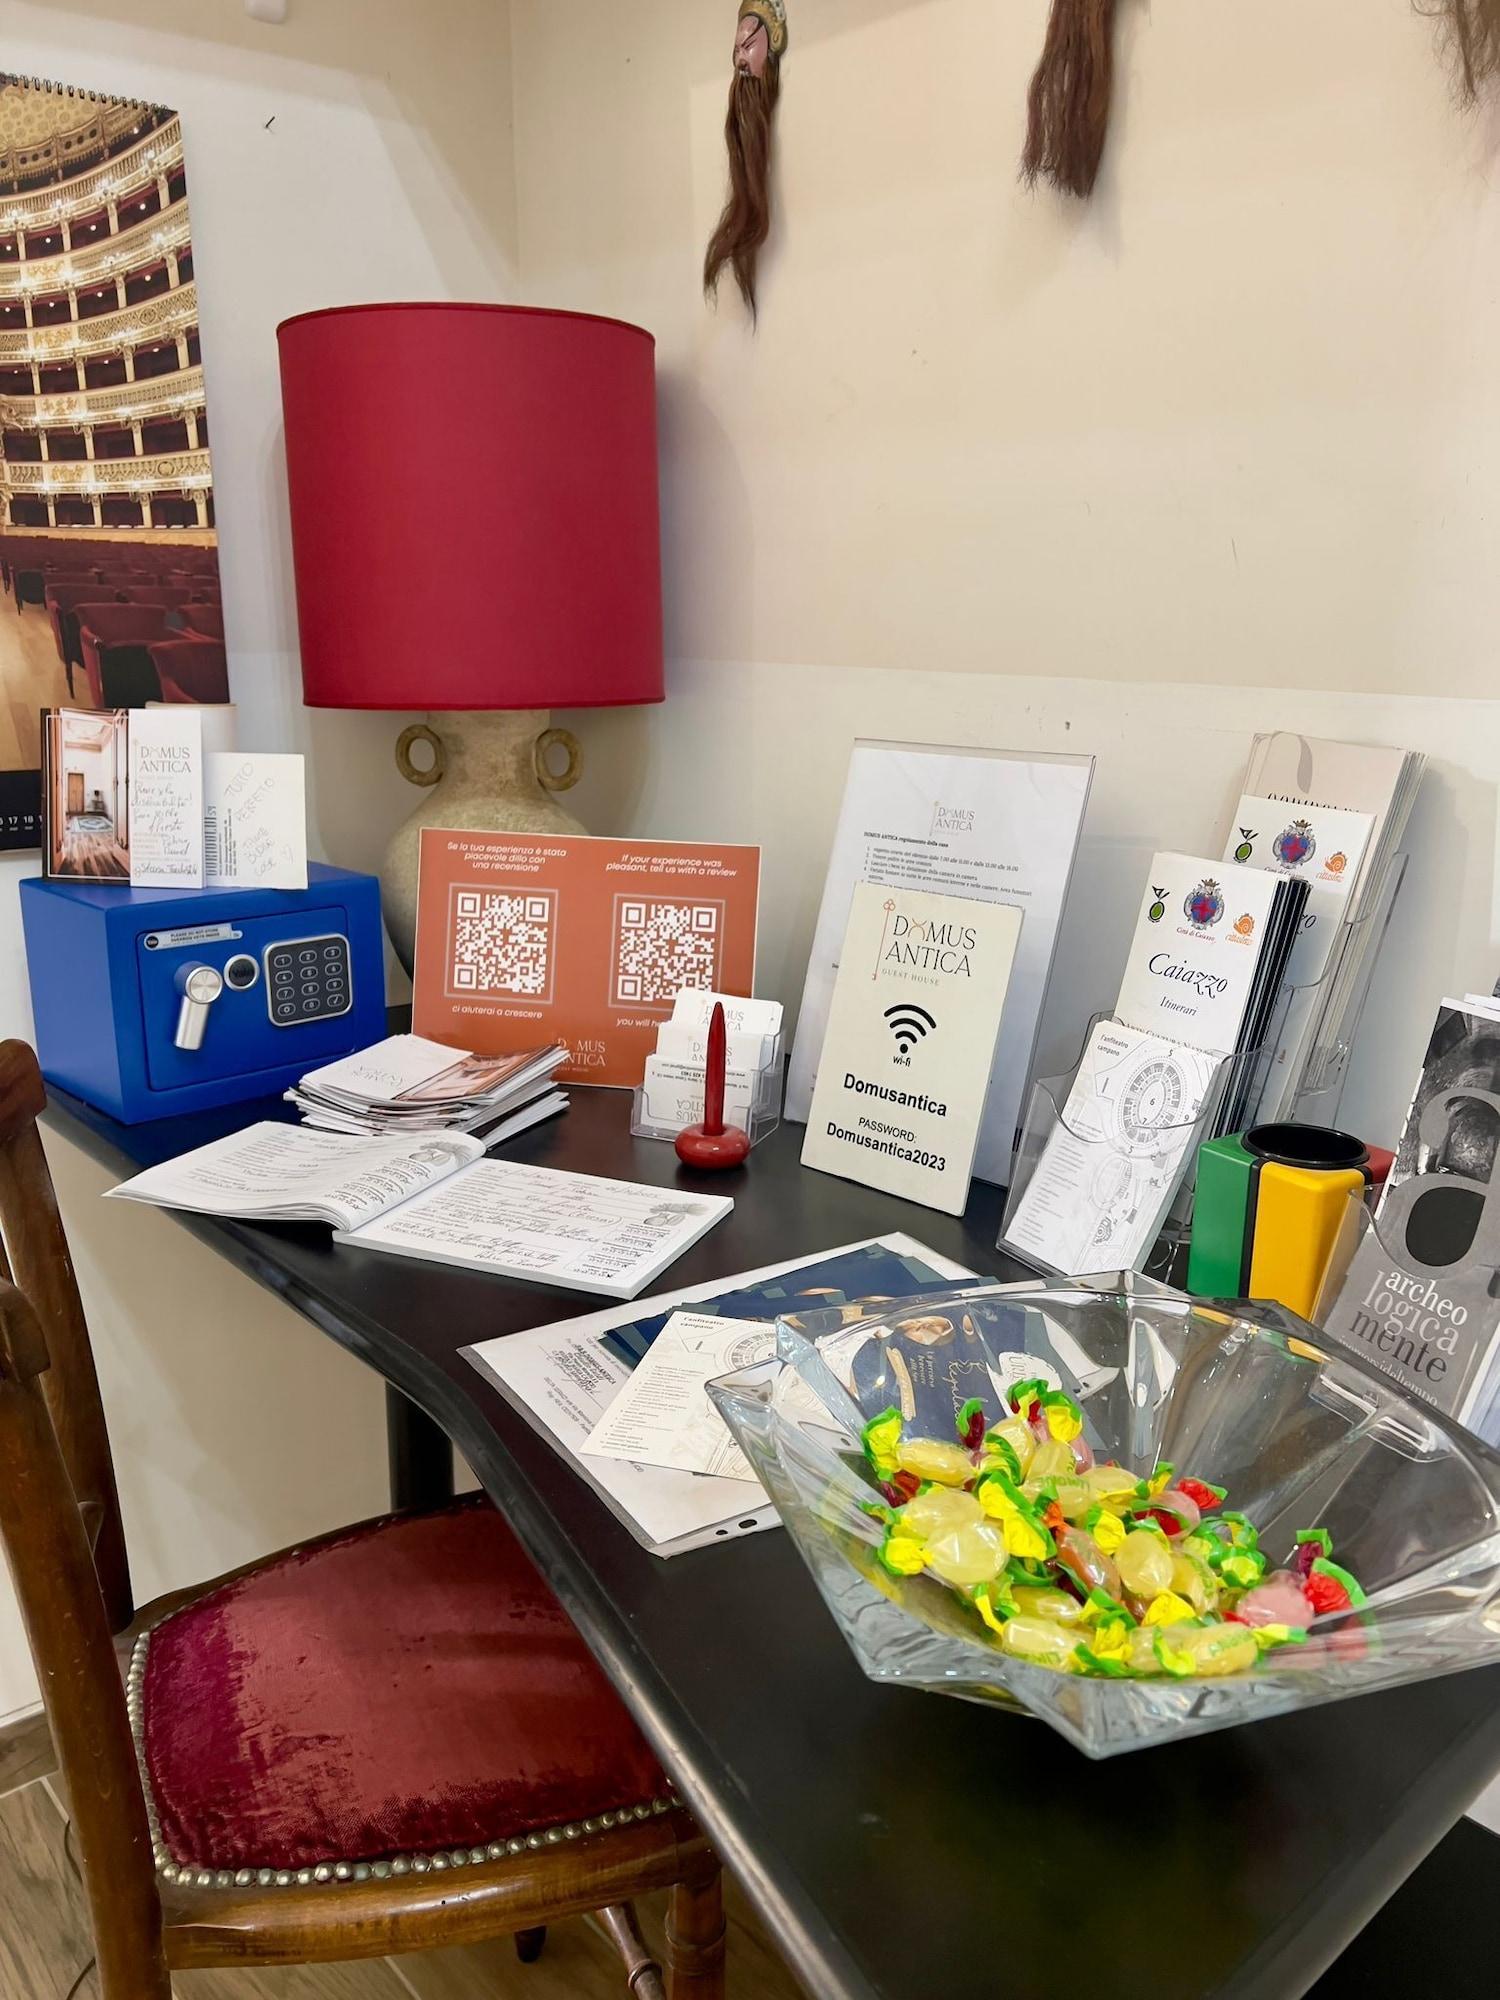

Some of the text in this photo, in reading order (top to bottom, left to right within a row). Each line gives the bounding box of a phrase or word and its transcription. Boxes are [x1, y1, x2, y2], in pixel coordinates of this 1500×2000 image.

[139, 760, 192, 773] ANTICA
[8, 816, 18, 825] 17
[24, 815, 34, 824] 18
[935, 818, 973, 832] ANTICA
[447, 842, 458, 850] Se
[459, 842, 468, 851] la
[470, 843, 485, 852] tua
[486, 845, 534, 854] esperienza
[543, 848, 567, 857] stata
[464, 852, 507, 861] piacevole
[508, 853, 528, 863] dillo
[629, 855, 651, 864] your
[651, 856, 702, 867] experience
[703, 860, 722, 868] was
[472, 861, 540, 873] una recensione
[649, 863, 664, 873] tell
[665, 865, 676, 874] us
[677, 865, 697, 875] with
[706, 868, 738, 877] review
[885, 941, 971, 977] ANTICA
[882, 968, 940, 986] GUEST HOUSE
[1149, 953, 1228, 999] Caiazzo
[452, 1005, 543, 1019] ci aiuterai a crescere
[1160, 996, 1198, 1016] Itinerari
[616, 1017, 634, 1027] you
[635, 1018, 650, 1028] will
[1097, 1044, 1120, 1057] campano
[893, 1055, 911, 1067] wi-fi
[843, 1073, 947, 1117] Domusantica
[1149, 1098, 1156, 1106] 6
[858, 1117, 917, 1144] PASSWORD:
[826, 1121, 946, 1172] Domusantica2023
[1385, 1271, 1468, 1326] archeo
[1361, 1269, 1460, 1356] logica
[680, 1322, 714, 1330] campano
[1349, 1310, 1447, 1383] mente
